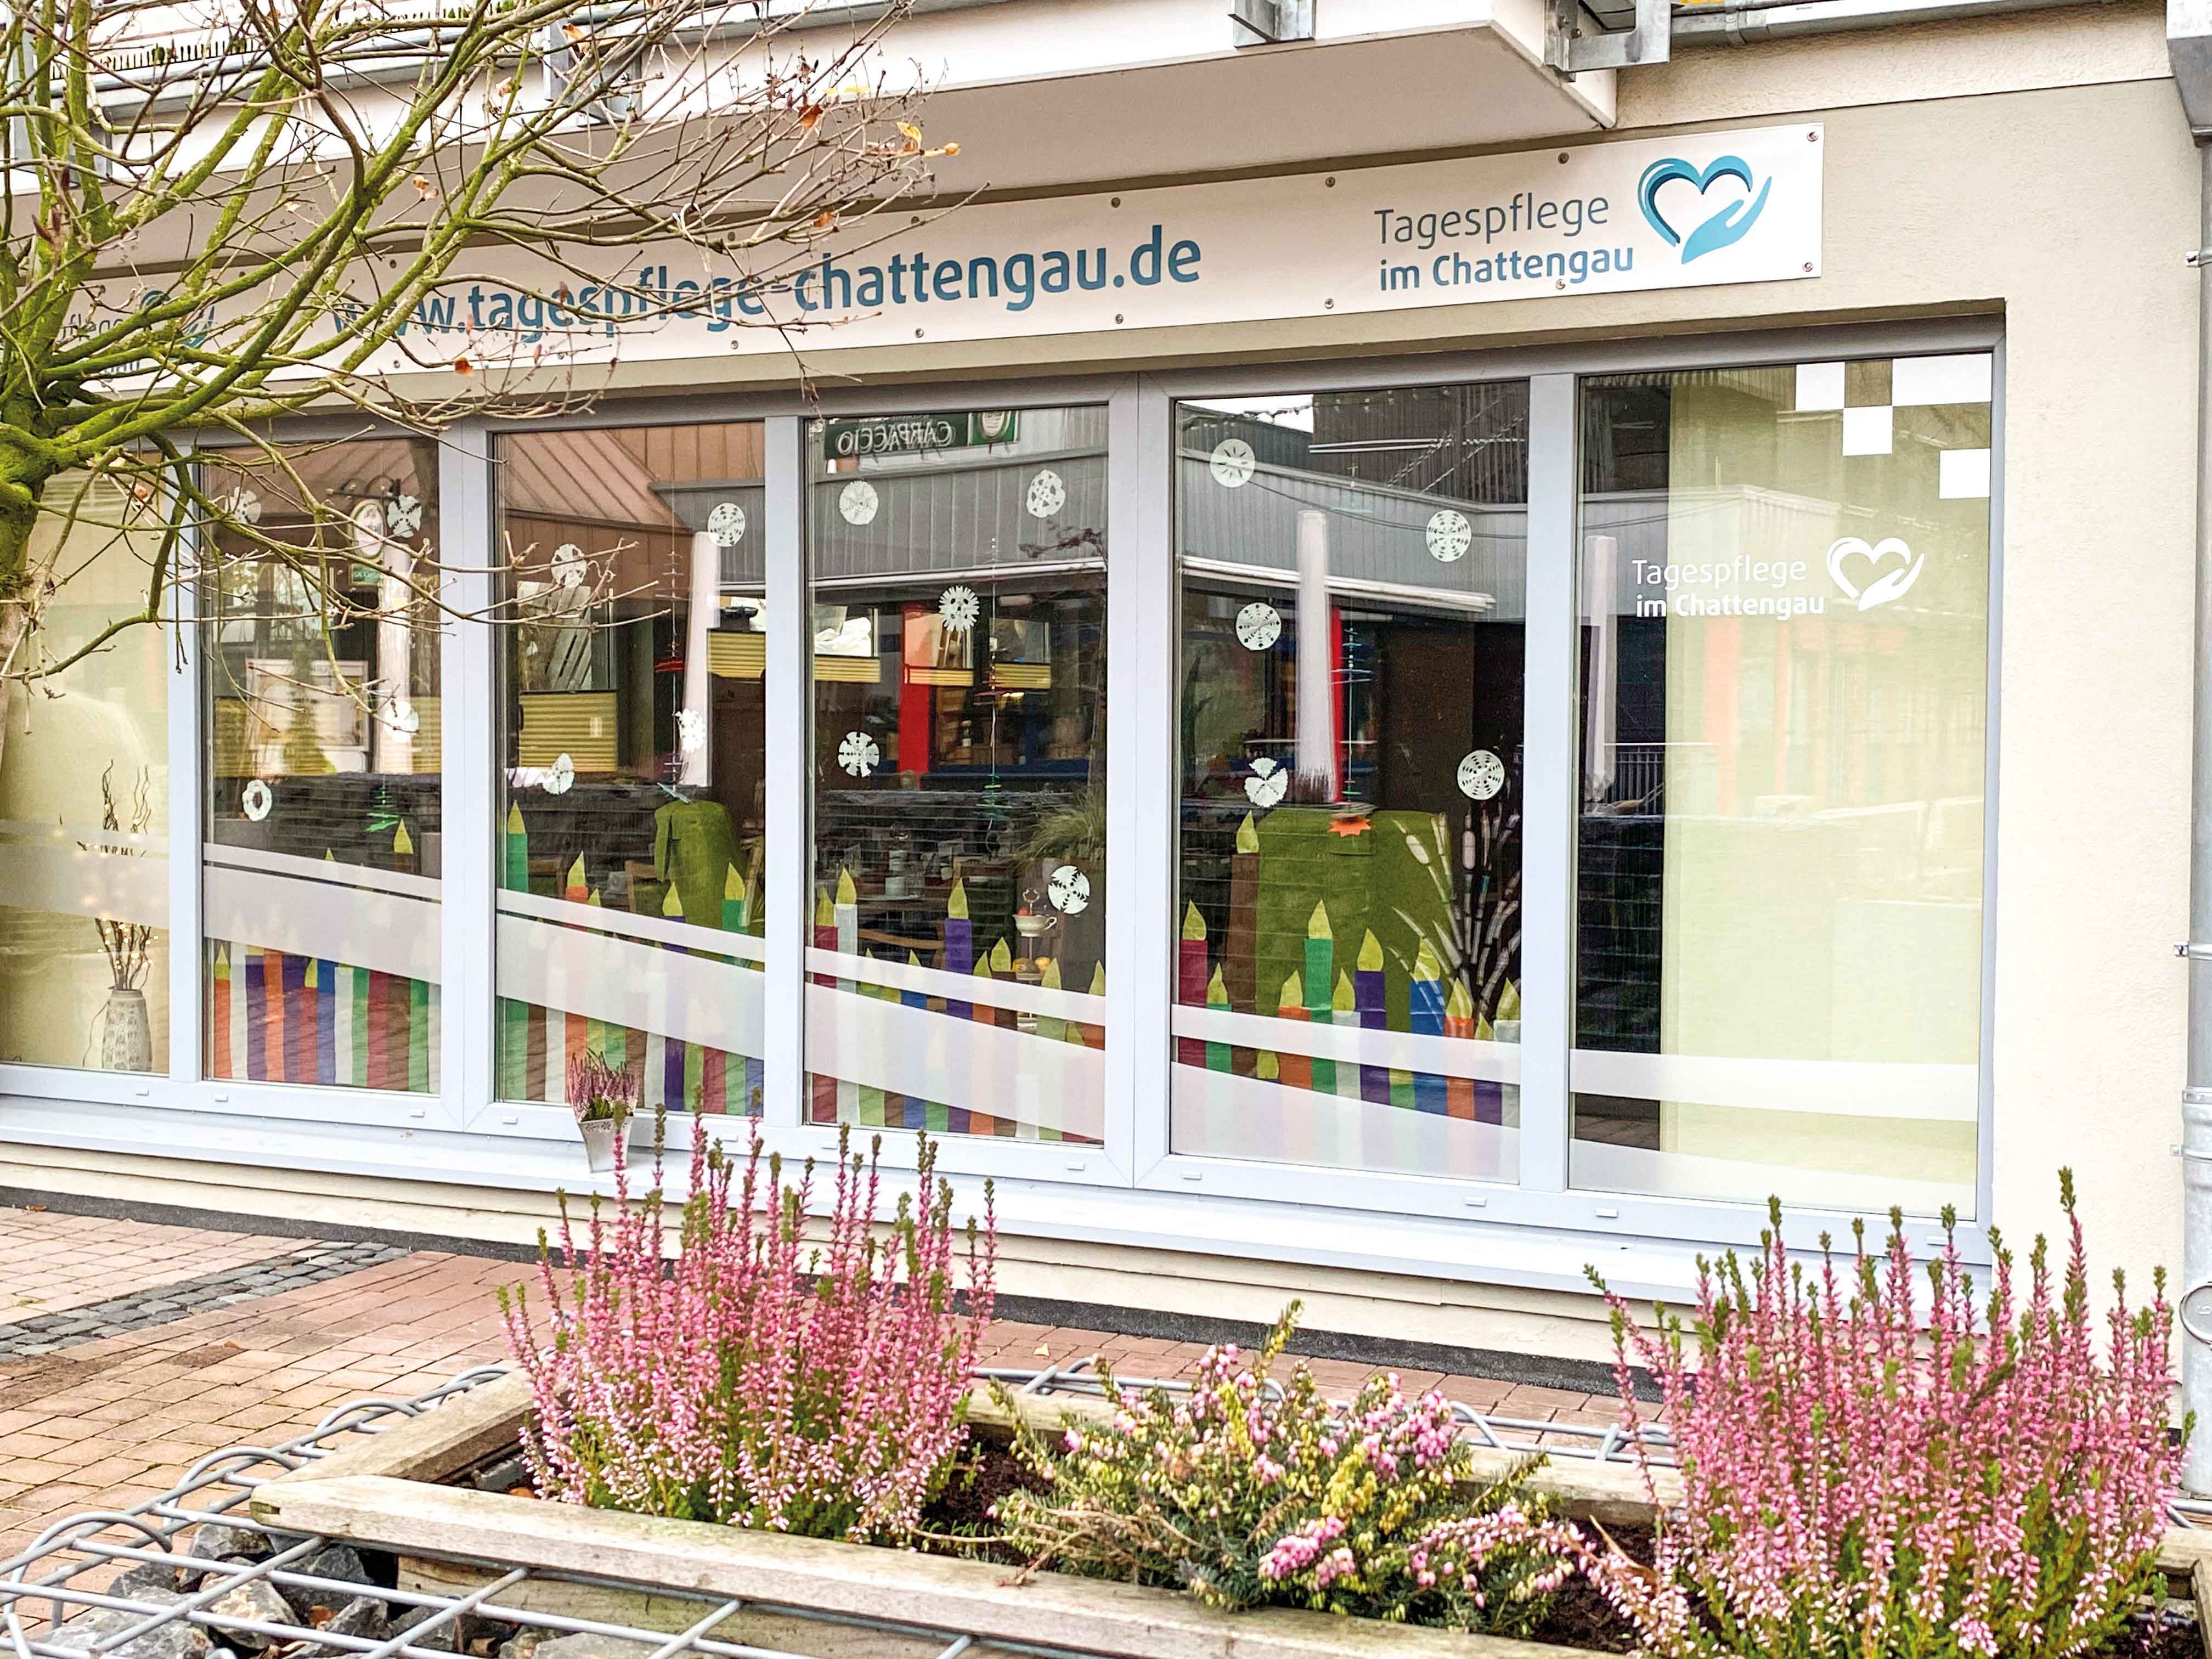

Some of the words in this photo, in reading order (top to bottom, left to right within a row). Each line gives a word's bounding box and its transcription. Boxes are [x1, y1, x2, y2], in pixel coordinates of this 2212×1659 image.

[1374, 192, 1609, 250] Tagespflege
[1380, 259, 1420, 291] im
[1432, 247, 1634, 284] Chattengau
[1632, 554, 1807, 591] Tagespflege
[1637, 594, 1667, 618] im
[1675, 594, 1825, 620] Chattengau
